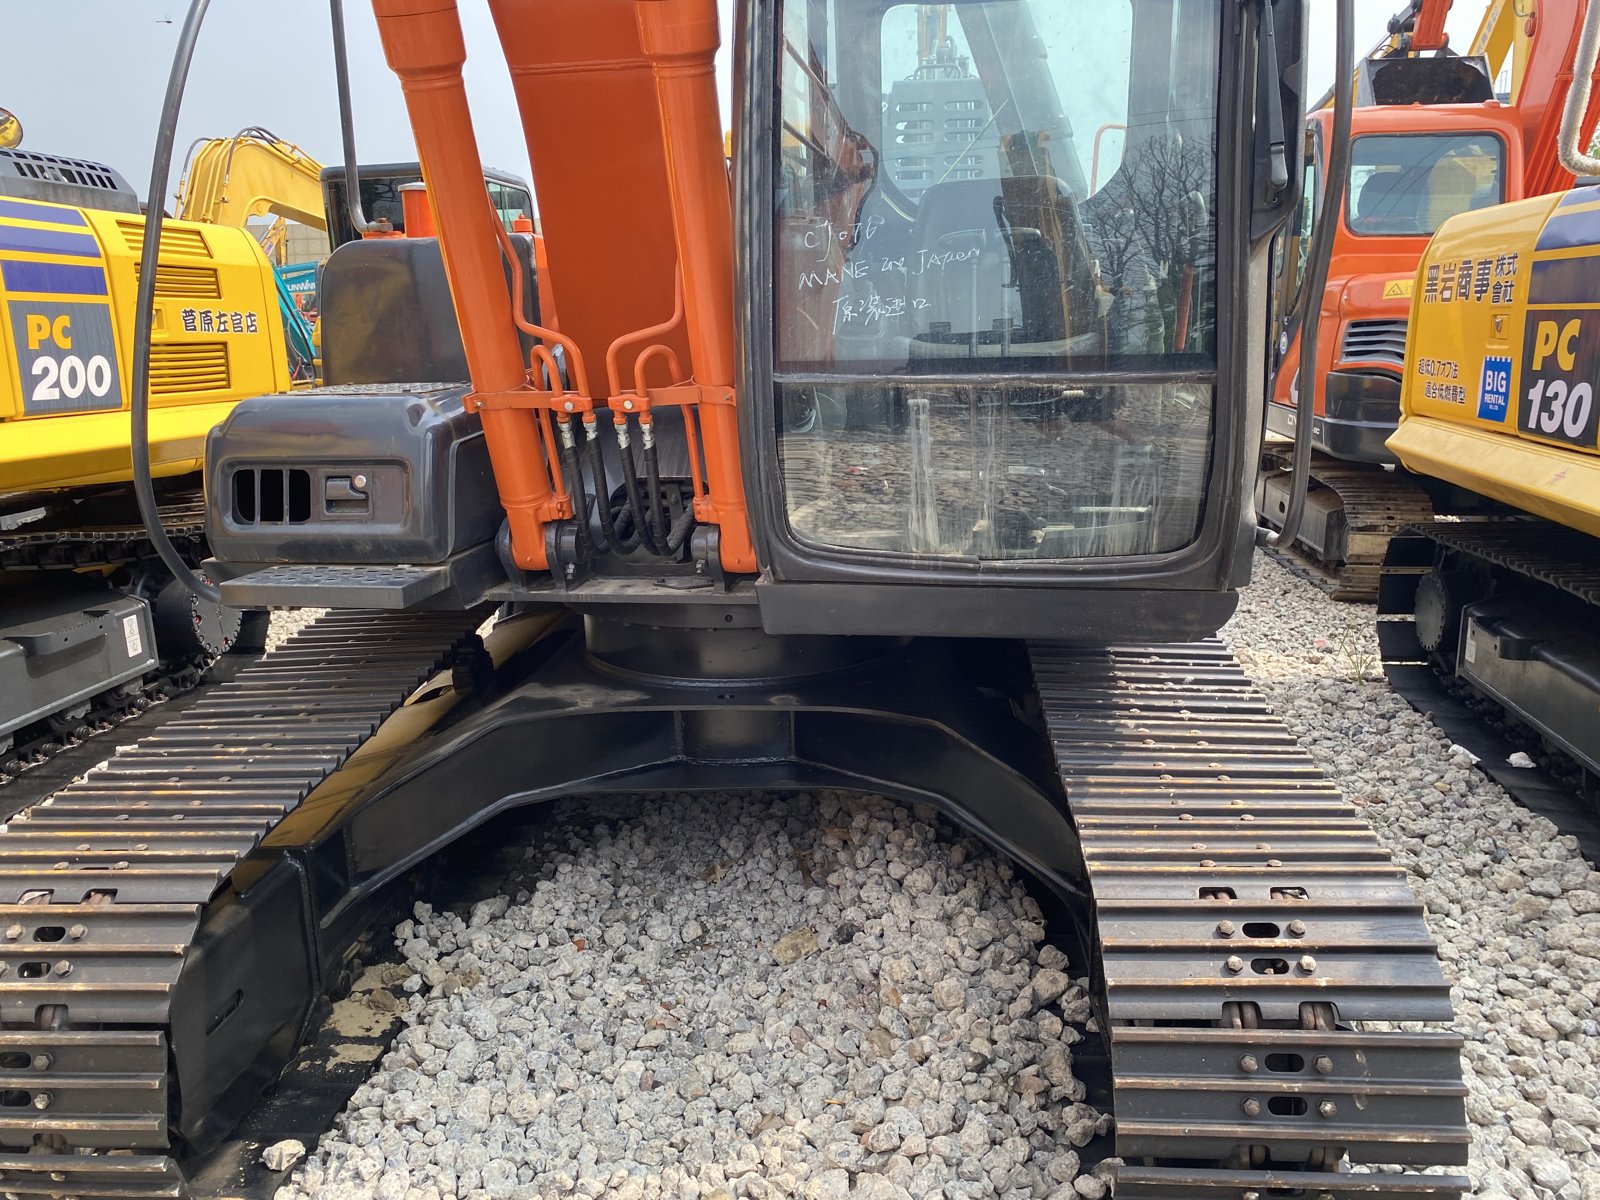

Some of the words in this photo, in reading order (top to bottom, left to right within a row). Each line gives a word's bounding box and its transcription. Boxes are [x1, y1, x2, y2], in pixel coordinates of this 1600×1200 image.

[26, 314, 72, 350] PC
[1531, 318, 1582, 372] PC
[31, 354, 112, 401] 200
[1485, 370, 1506, 393] BIG
[1484, 393, 1505, 406] RENTAL
[1527, 379, 1593, 438] 130
